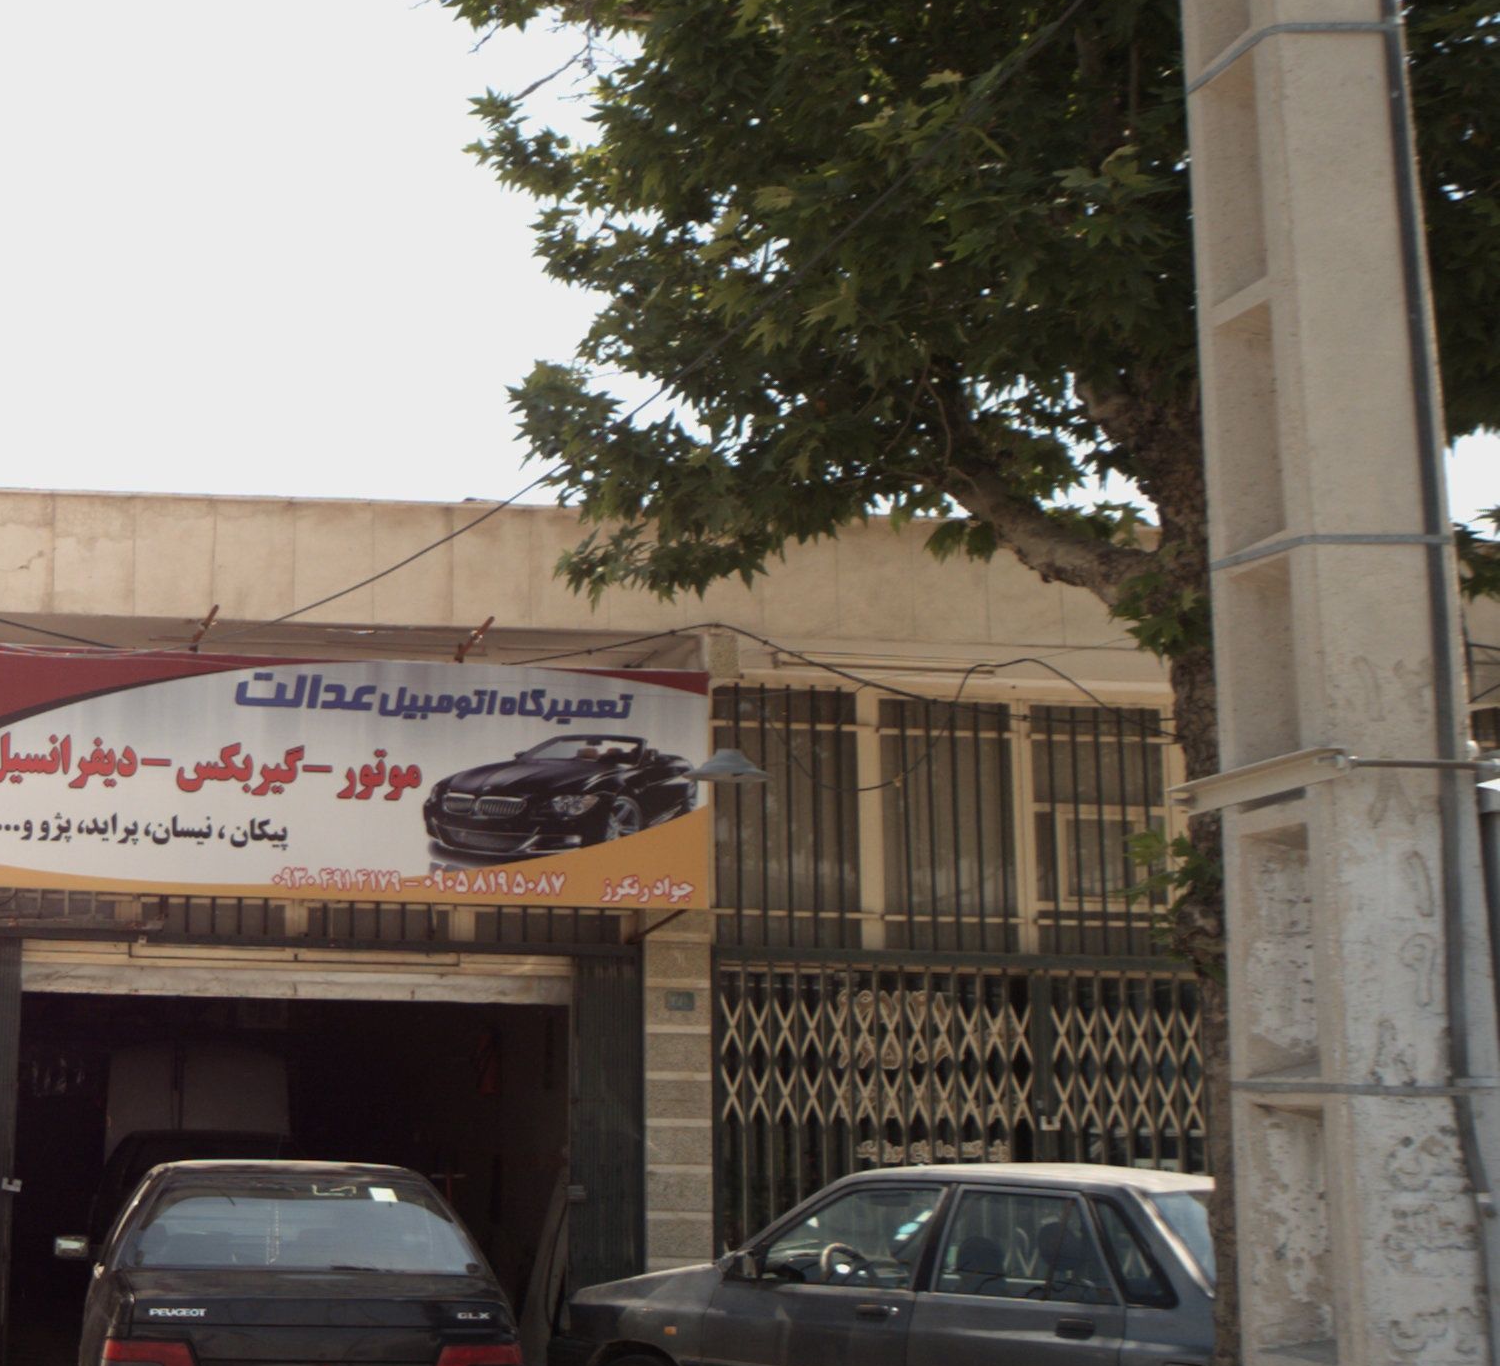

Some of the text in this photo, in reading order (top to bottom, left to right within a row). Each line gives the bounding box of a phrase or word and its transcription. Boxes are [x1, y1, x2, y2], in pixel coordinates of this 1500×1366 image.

[234, 671, 634, 726] تعمیرگاه اتومبیل عدالت
[176, 741, 305, 796] گیربکس
[336, 747, 423, 801] موتور
[37, 812, 72, 843] پژو
[600, 874, 695, 904] جواد رنگرز
[148, 1307, 207, 1317] PEUGEOT
[457, 1312, 491, 1320] GLX
